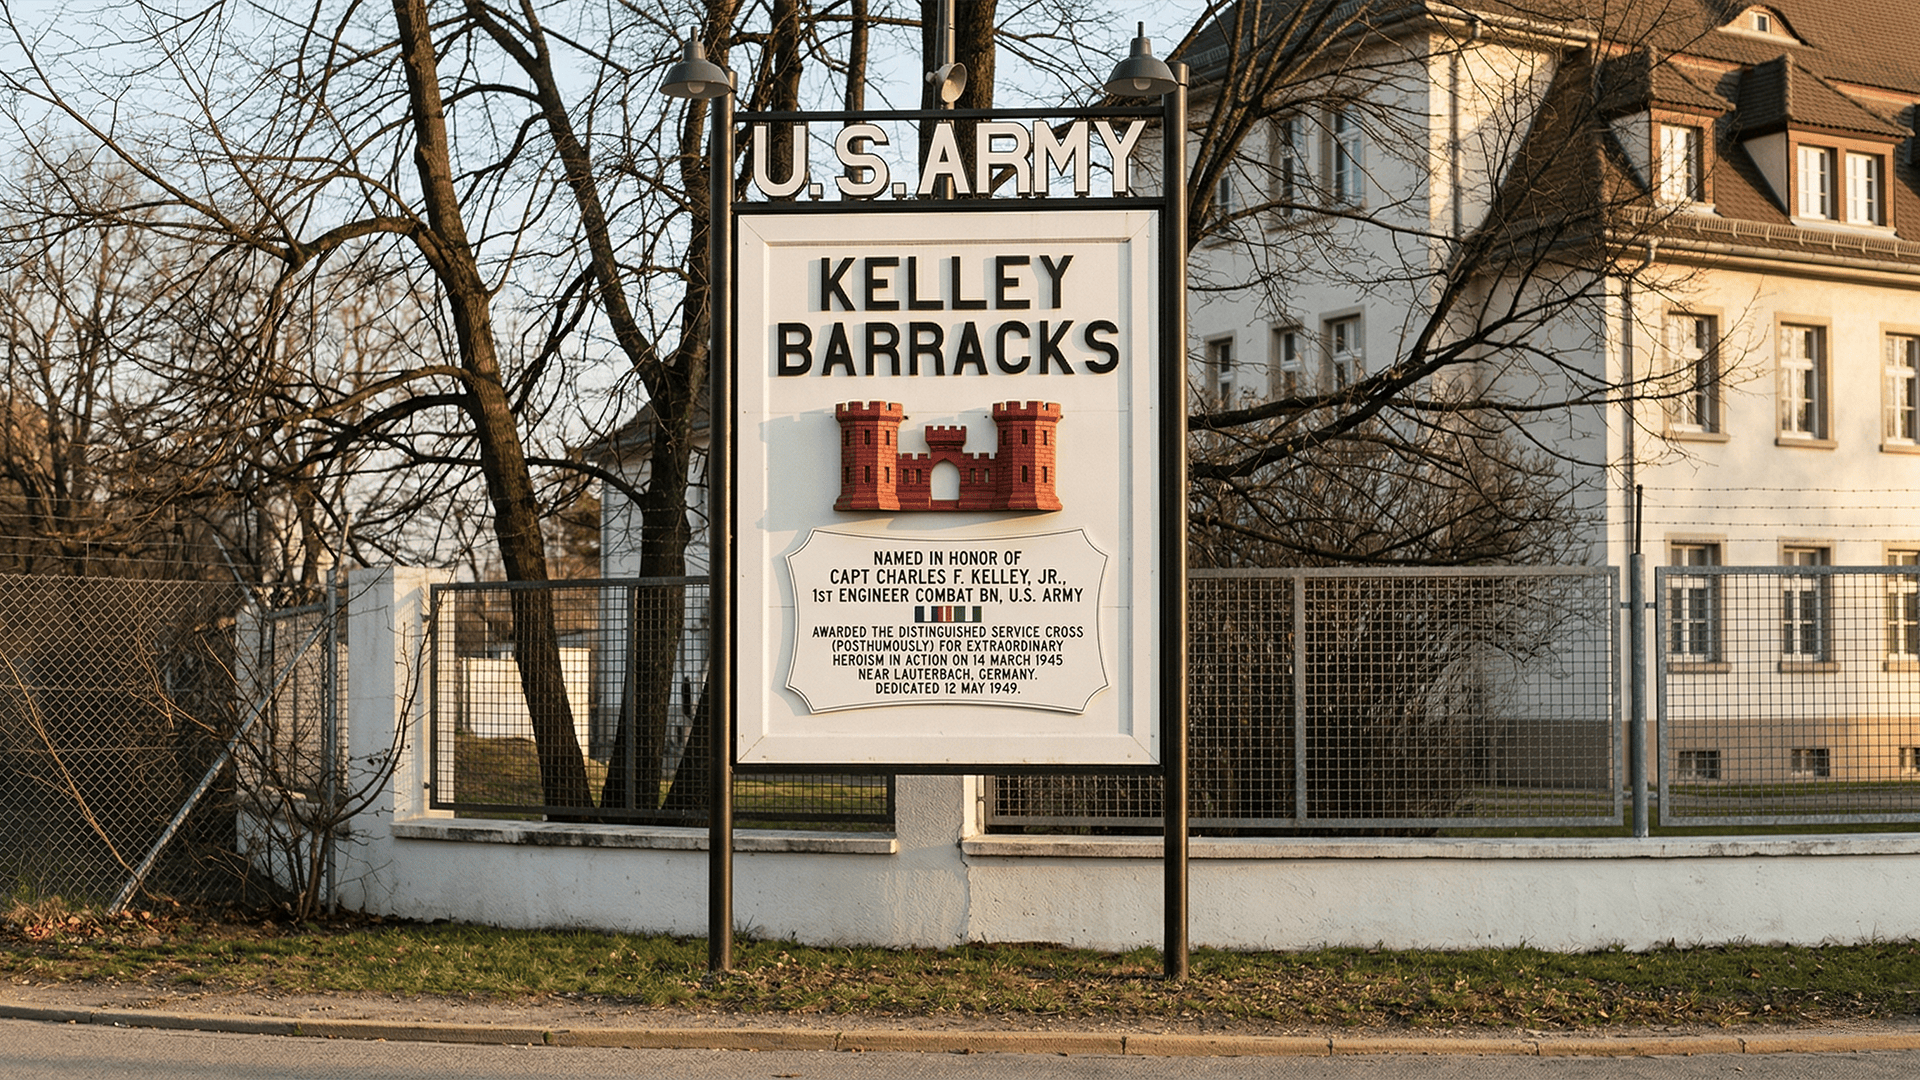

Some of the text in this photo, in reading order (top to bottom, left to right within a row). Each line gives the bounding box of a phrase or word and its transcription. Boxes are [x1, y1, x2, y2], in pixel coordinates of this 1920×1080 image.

[917, 119, 1147, 198] ARMY
[821, 255, 1074, 311] KELLEY
[777, 320, 1120, 376] BARRACKS
[873, 550, 1022, 566] NAMED IN HONOR OF
[830, 568, 1067, 586] CAPT CHARLES F. KELLEY, JR.,
[839, 587, 910, 603] ENGINEER
[915, 587, 974, 603] COMBAT
[979, 587, 1003, 605] BN,
[1009, 587, 1036, 603] U.S.
[1042, 587, 1084, 603] ARMY
[812, 625, 1084, 638] AWARDED THE DISTINGUISHED SERVICE CROSS
[831, 639, 1064, 653] (POSTHUMOUSLY) FOR EXTRAORDINARY
[832, 653, 1064, 667] HEROISM IN ACTION ON 14 MARCH 1945
[858, 667, 1038, 681] NEAR LAUTERBACH, GERMANY.
[875, 682, 1021, 695] DEDICATED 12 MAY 1949.
